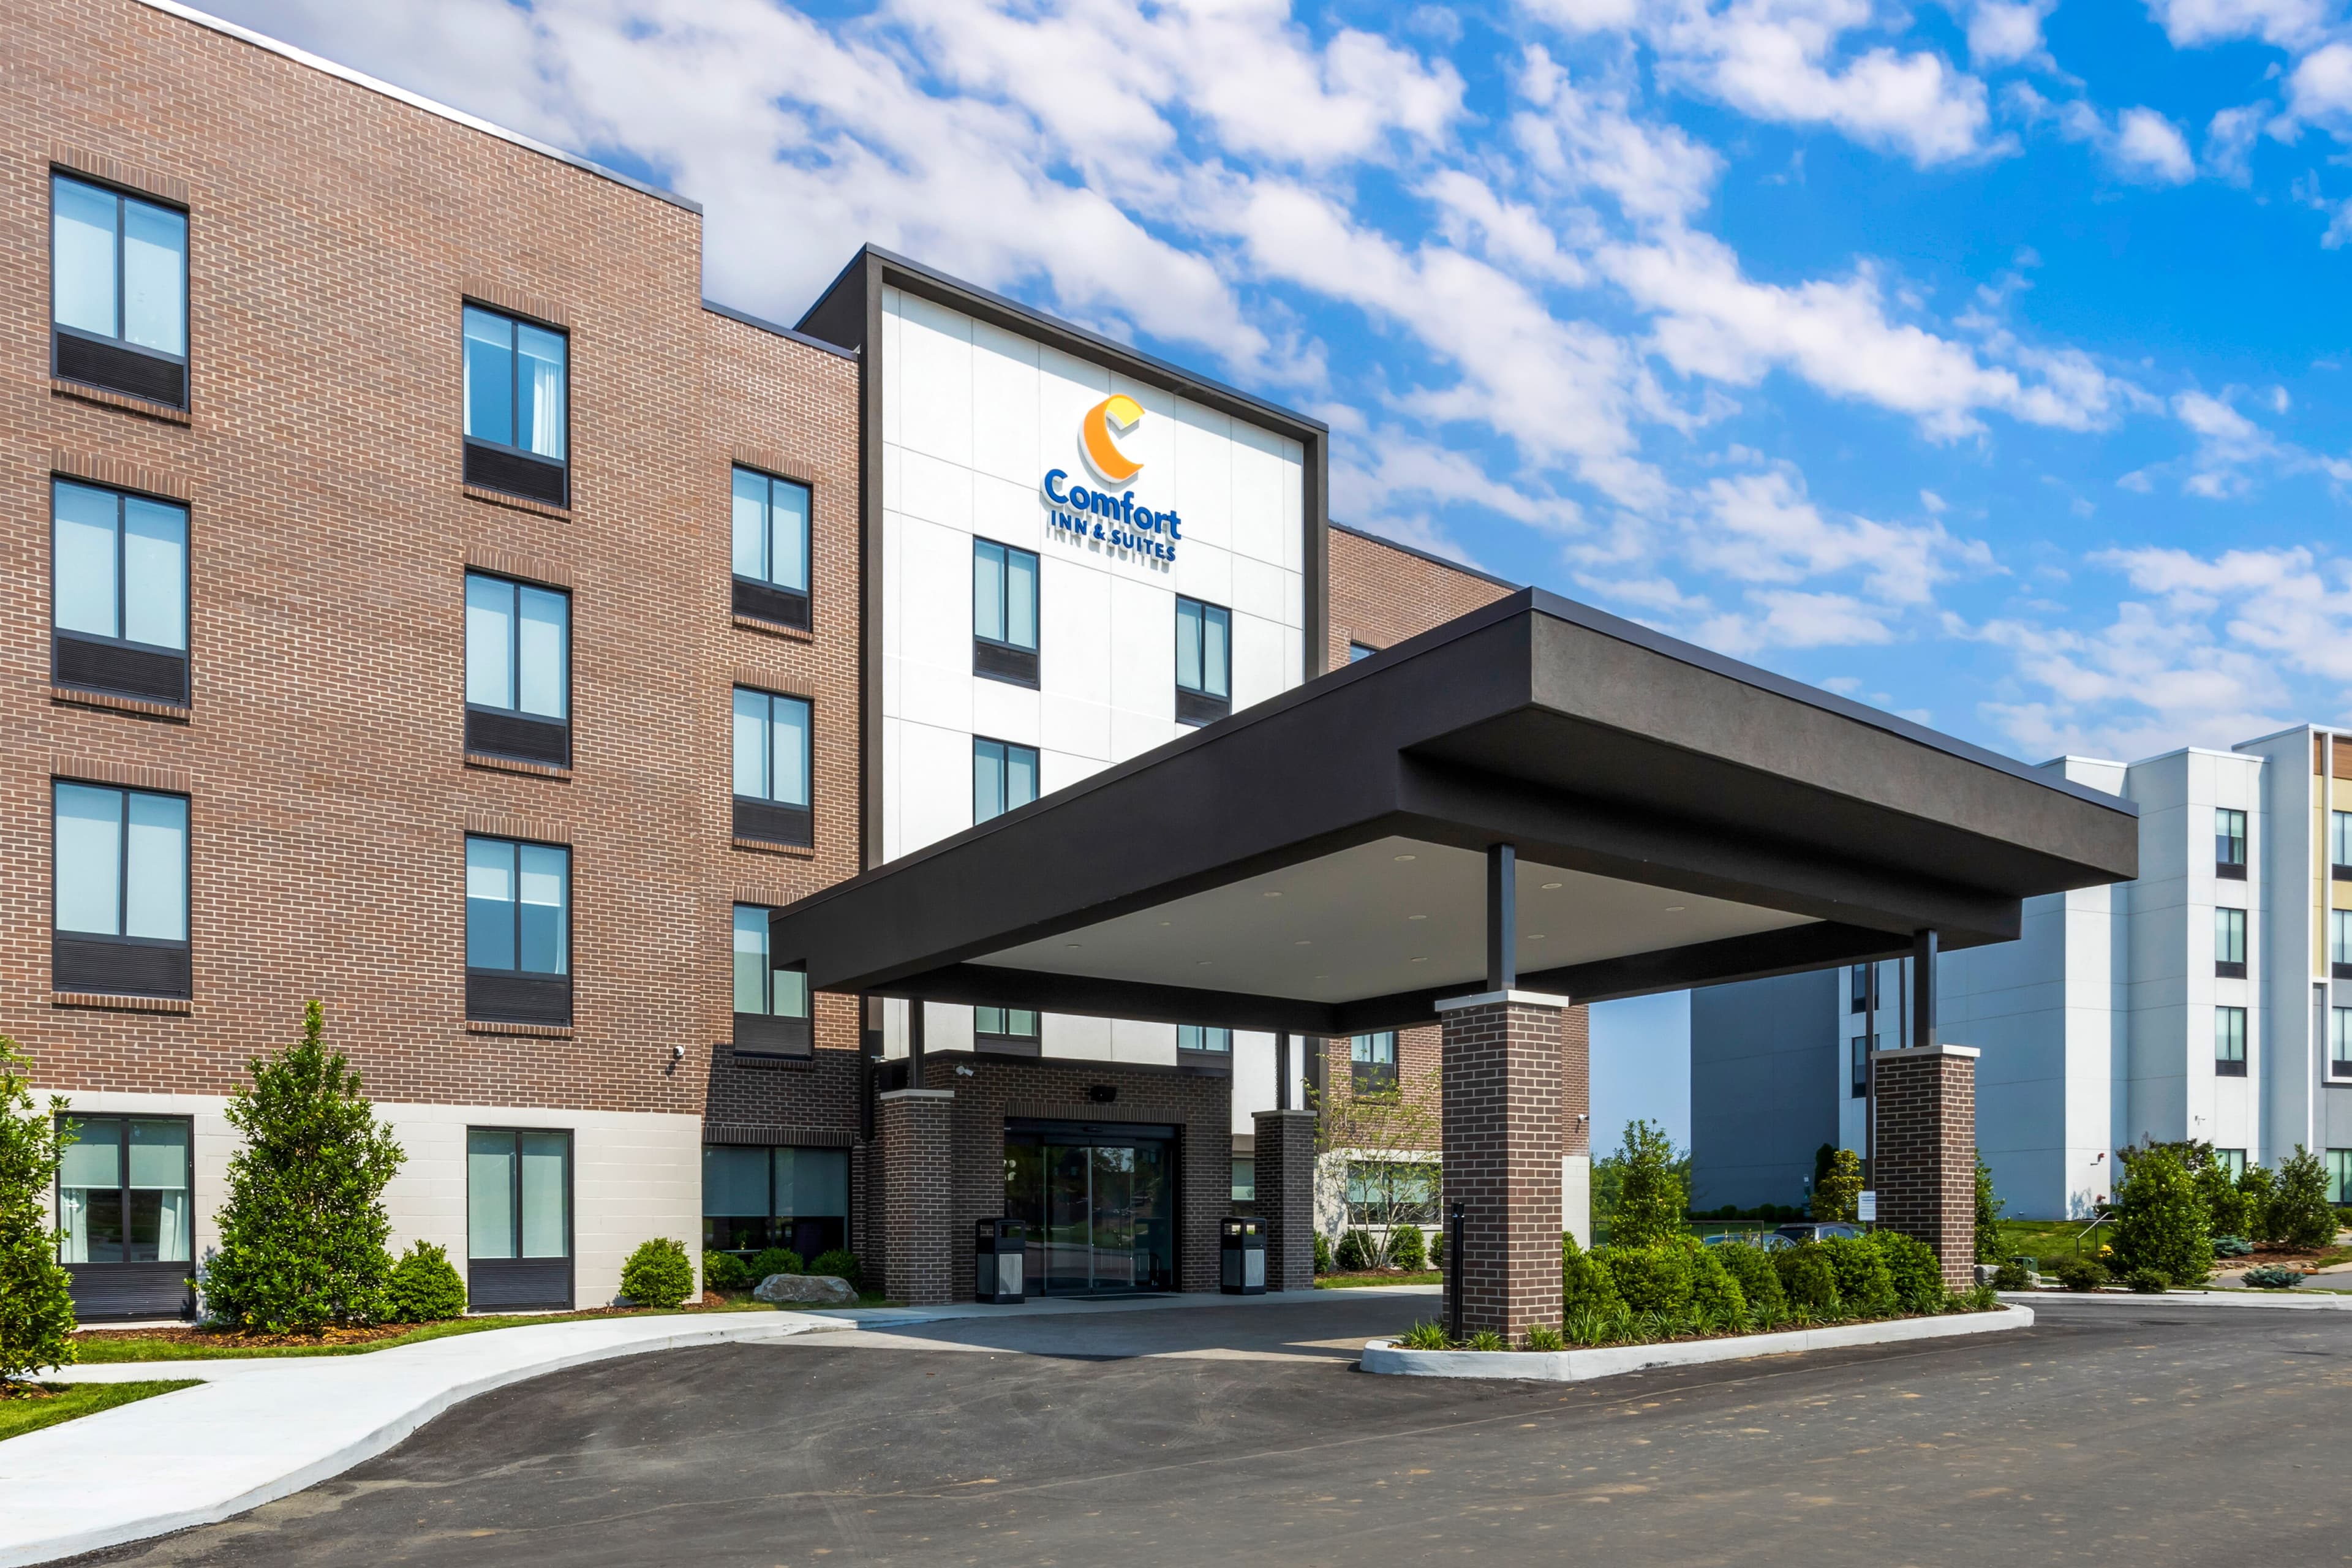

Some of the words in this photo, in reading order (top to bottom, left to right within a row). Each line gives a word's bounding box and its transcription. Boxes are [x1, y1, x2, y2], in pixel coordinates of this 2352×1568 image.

[1044, 469, 1182, 540] Comfort
[1050, 510, 1087, 535] INN
[1093, 523, 1106, 540] &
[1111, 529, 1176, 562] SUITES
